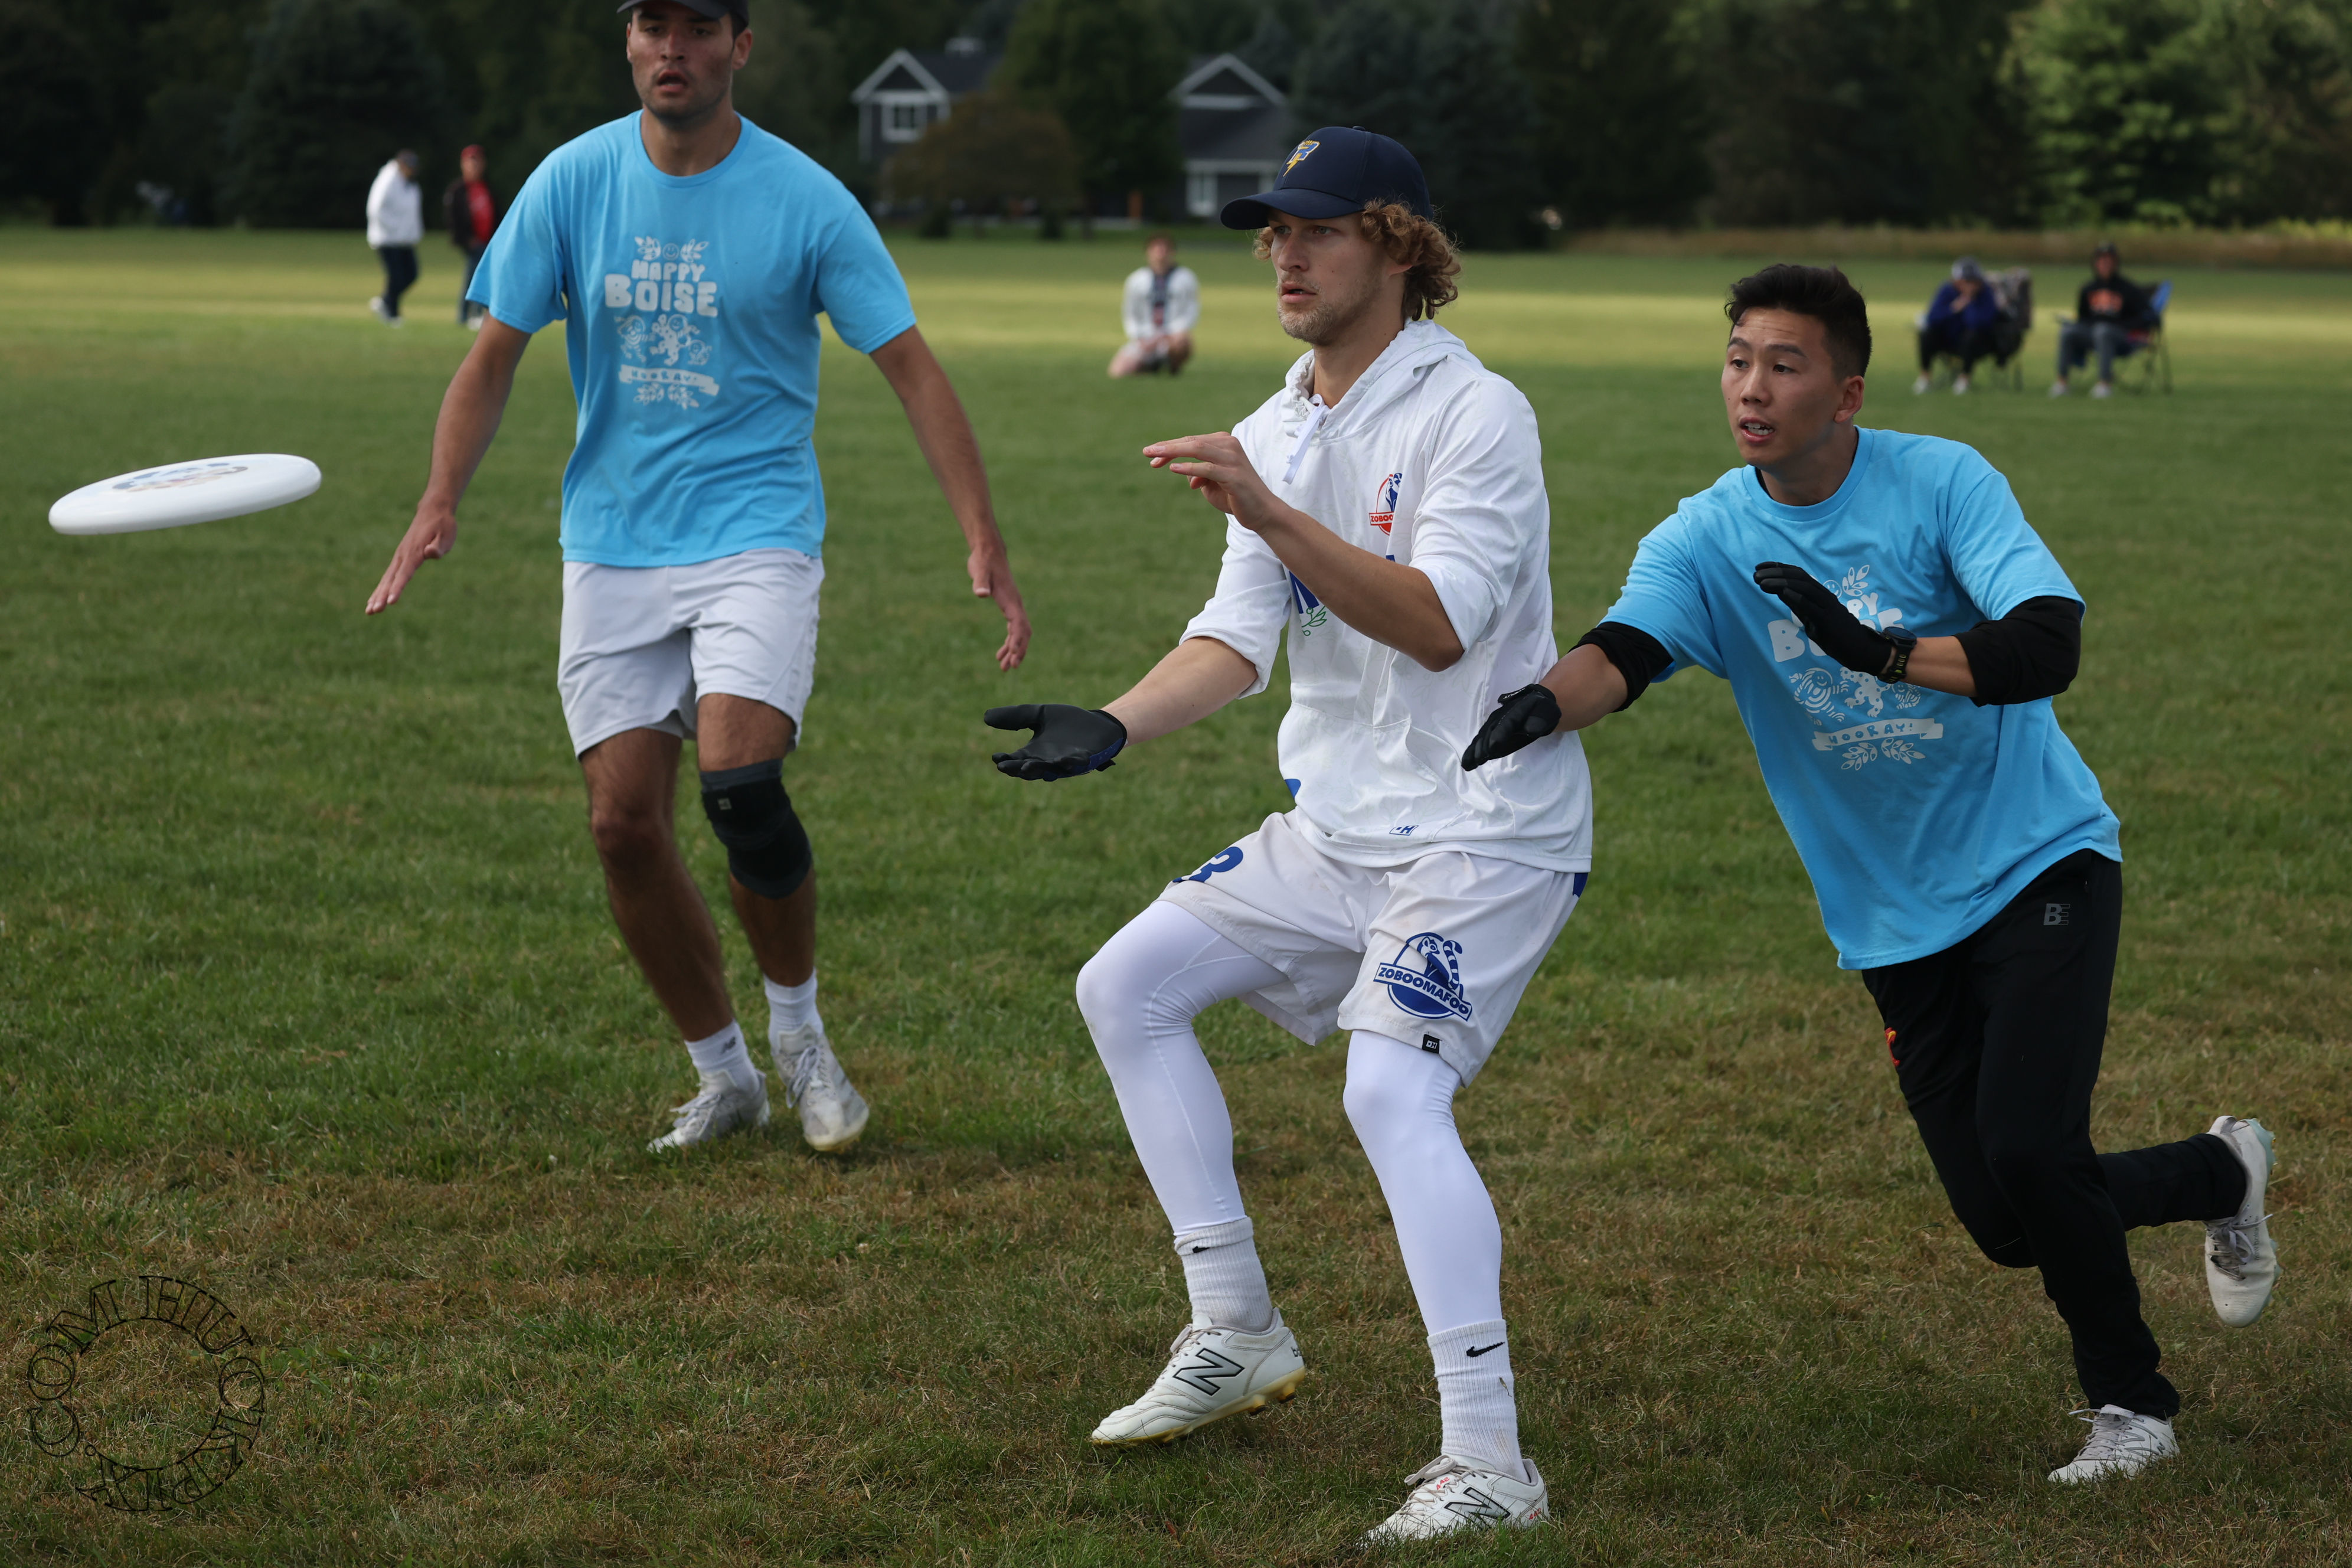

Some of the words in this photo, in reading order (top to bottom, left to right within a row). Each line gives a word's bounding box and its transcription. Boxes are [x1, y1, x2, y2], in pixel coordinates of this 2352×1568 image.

[631, 259, 705, 282] HAPPY
[604, 273, 718, 318] BOISE
[1829, 723, 1913, 744] HOORAY!
[1378, 967, 1469, 1015] ZOBOOMAFOO
[1436, 1476, 1450, 1491] 442
